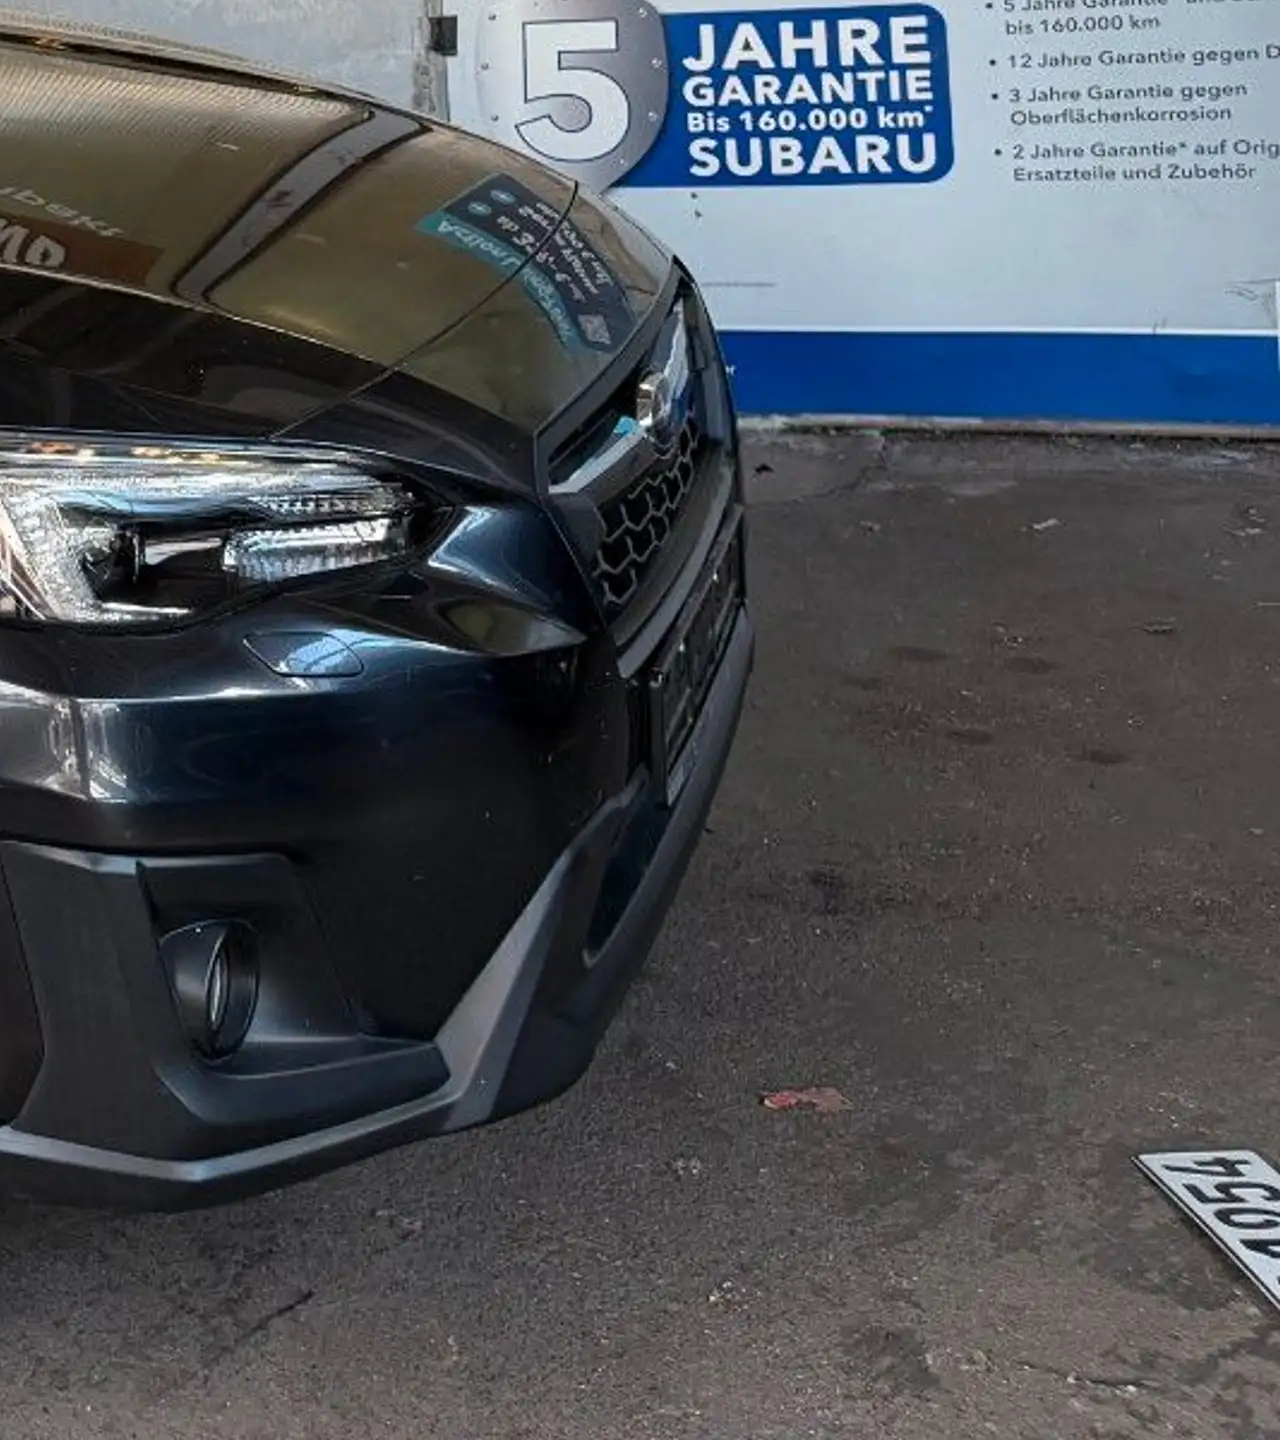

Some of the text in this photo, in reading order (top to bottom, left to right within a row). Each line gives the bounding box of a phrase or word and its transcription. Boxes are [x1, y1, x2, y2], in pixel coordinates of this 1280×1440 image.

[1005, 13, 1160, 35] bis 160.000 km
[682, 14, 929, 73] JAHRE
[1009, 54, 1032, 69] 12
[1037, 51, 1091, 68] Jahre
[1098, 48, 1185, 65] Garantie
[1192, 48, 1260, 66] gegen
[514, 17, 631, 162] 5
[683, 69, 934, 107] GARANTIE
[1009, 81, 1248, 103] 3 Jahre Garantie gegen
[687, 111, 730, 133] Bis
[740, 109, 868, 132] 160.000
[1011, 106, 1232, 126] Oberflächenkorrosion
[689, 132, 937, 177] SUBARU
[1013, 144, 1025, 160] 2
[1030, 142, 1084, 159] Jahre
[1193, 139, 1227, 155] auf
[1233, 138, 1280, 159] Orig
[1013, 162, 1257, 181] Ersatzteile und Zubehör
